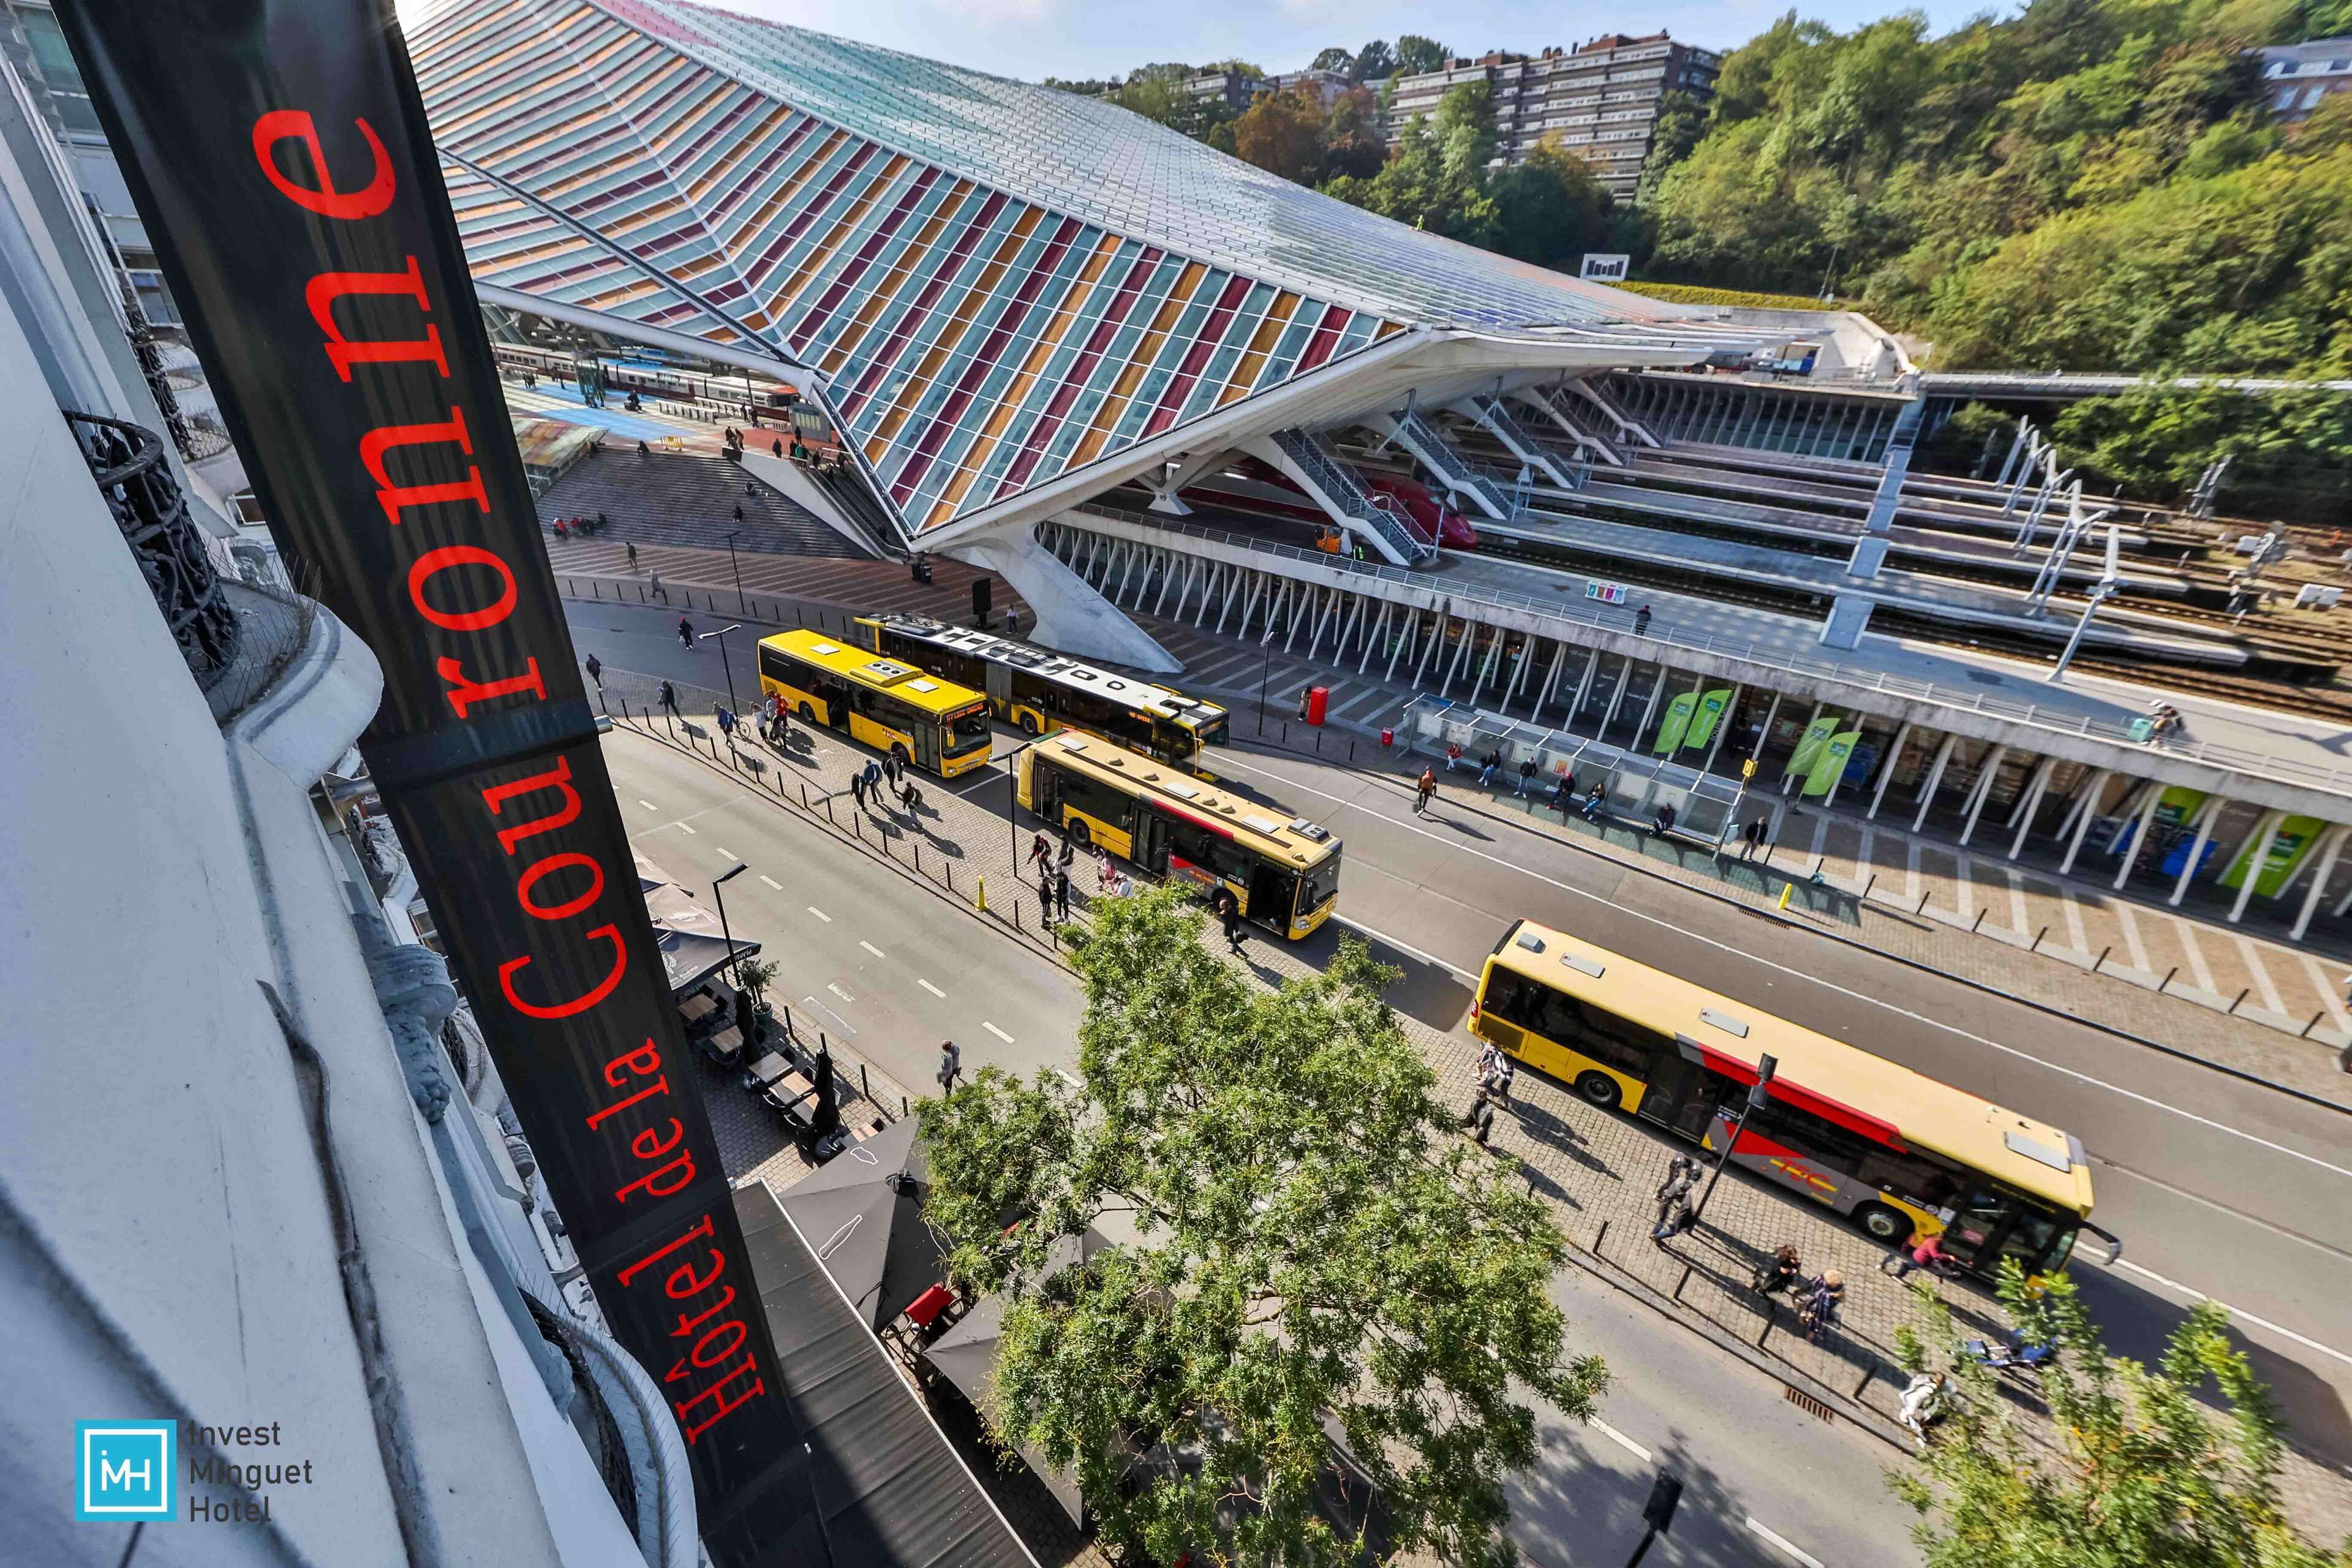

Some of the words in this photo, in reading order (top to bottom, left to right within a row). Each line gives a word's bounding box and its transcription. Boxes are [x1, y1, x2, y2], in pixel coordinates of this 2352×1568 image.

[252, 110, 627, 1019] Couronne
[1779, 1157, 1830, 1192] TEC
[618, 1215, 764, 1444] Hôtel
